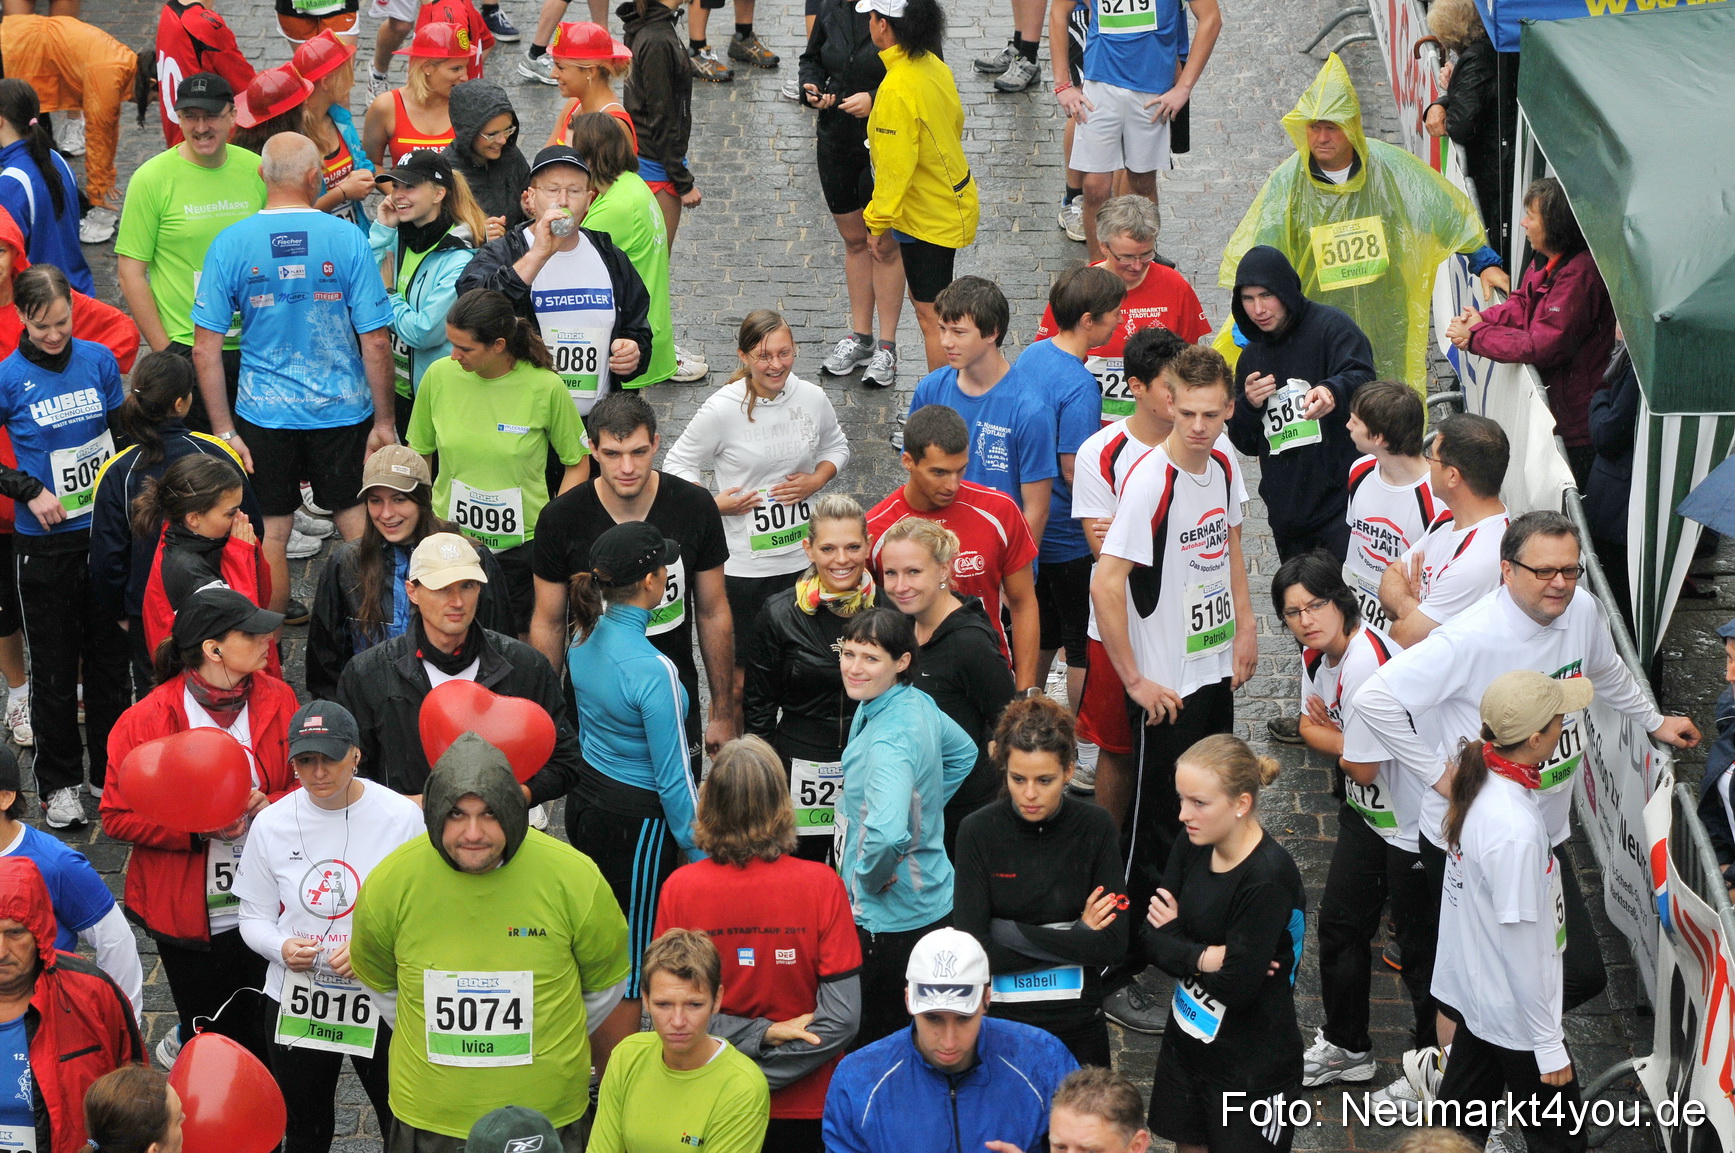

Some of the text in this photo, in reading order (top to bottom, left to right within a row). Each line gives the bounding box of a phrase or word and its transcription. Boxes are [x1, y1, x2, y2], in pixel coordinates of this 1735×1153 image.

[323, 164, 352, 185] DURST
[277, 238, 302, 246] Fischer
[1321, 233, 1381, 267] 5028
[323, 264, 334, 274] CG
[1341, 267, 1368, 279] Erwin
[314, 293, 341, 301] MEIER
[545, 293, 611, 307] STAEDTLER
[1120, 307, 1168, 317] 11. NEUMARKTER
[557, 331, 585, 340] BOCK
[1105, 361, 1124, 370] BOC
[563, 378, 582, 390] aver
[29, 387, 101, 420] HUBER
[49, 403, 101, 422] TECHNOLOGY
[52, 420, 67, 430] WASTE
[68, 416, 84, 426] WATER
[1280, 427, 1299, 441] stan
[764, 440, 802, 459] RIVER
[63, 450, 111, 493] 5084
[470, 491, 500, 503] BOCK
[455, 499, 517, 534] 5098
[753, 501, 812, 532] 5076
[1179, 517, 1225, 544] GERHART
[1351, 530, 1373, 542] utohaus
[470, 532, 499, 547] Katrin
[771, 530, 803, 547] Sandra
[1180, 540, 1207, 551] Autohaus
[1370, 542, 1401, 558] JANI
[1189, 560, 1202, 571] Das
[1365, 559, 1385, 575] sportlic
[1203, 579, 1224, 594] BOCK
[1191, 591, 1230, 633] 5196
[1203, 629, 1229, 645] Patrick
[818, 767, 844, 776] BOC
[1552, 767, 1571, 784] Hans
[800, 779, 844, 807] 52
[328, 933, 349, 943] MIT
[727, 926, 781, 935] STADTLAUF
[784, 926, 807, 935] 2011
[777, 951, 794, 959] DEE
[313, 973, 354, 986] BOCK
[457, 977, 501, 989] BOCK
[1013, 971, 1058, 989] Isabell
[291, 985, 372, 1025] 5016
[1174, 985, 1198, 1022] Simone
[436, 996, 524, 1032] 5074
[309, 1023, 344, 1042] Tanja
[461, 1039, 495, 1054] Ivica
[13, 1052, 28, 1061] 12.
[680, 1132, 706, 1148] iREM
